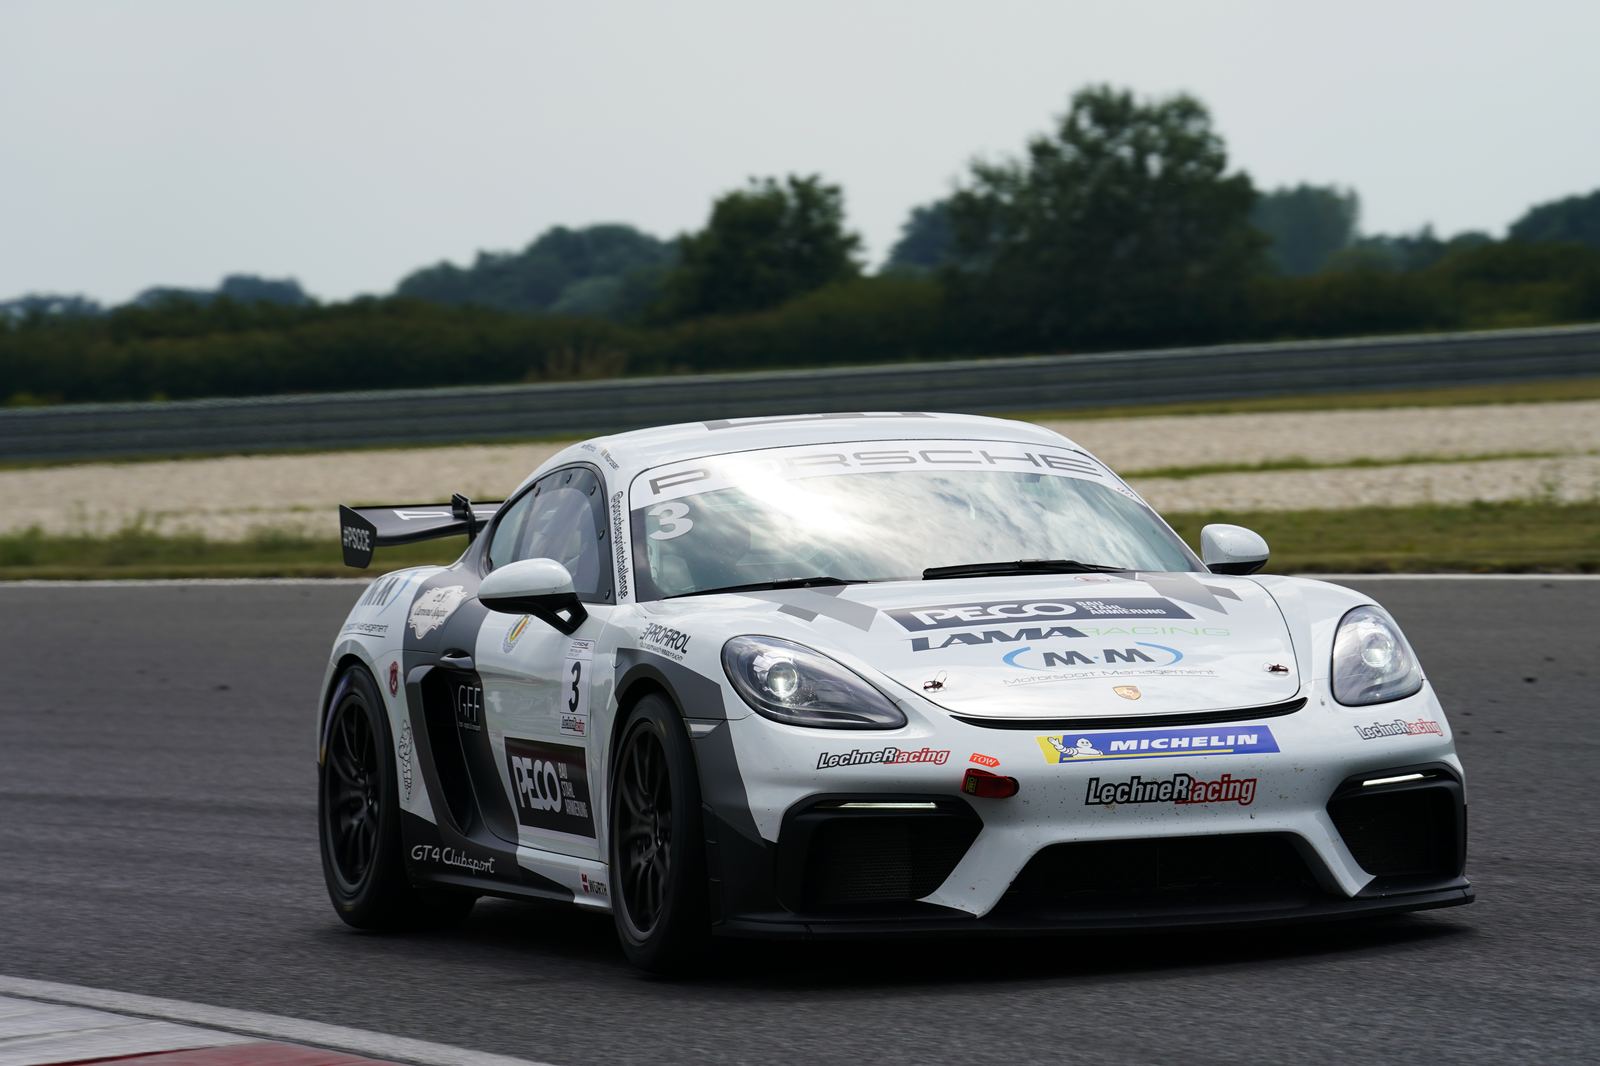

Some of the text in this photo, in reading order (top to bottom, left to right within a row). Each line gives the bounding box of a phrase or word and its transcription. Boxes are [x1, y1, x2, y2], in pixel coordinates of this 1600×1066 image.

[649, 449, 1103, 494] PRSCHE
[648, 502, 694, 541] 3
[611, 490, 629, 600] @porschesprintchallenge
[909, 602, 1077, 625] PECO
[568, 661, 582, 713] 3
[1002, 669, 1216, 685] Motorsport Management
[1109, 734, 1258, 751] MICHELIN
[972, 753, 997, 766] TOW
[511, 755, 562, 813] PECO
[441, 847, 495, 875] Clubsport
